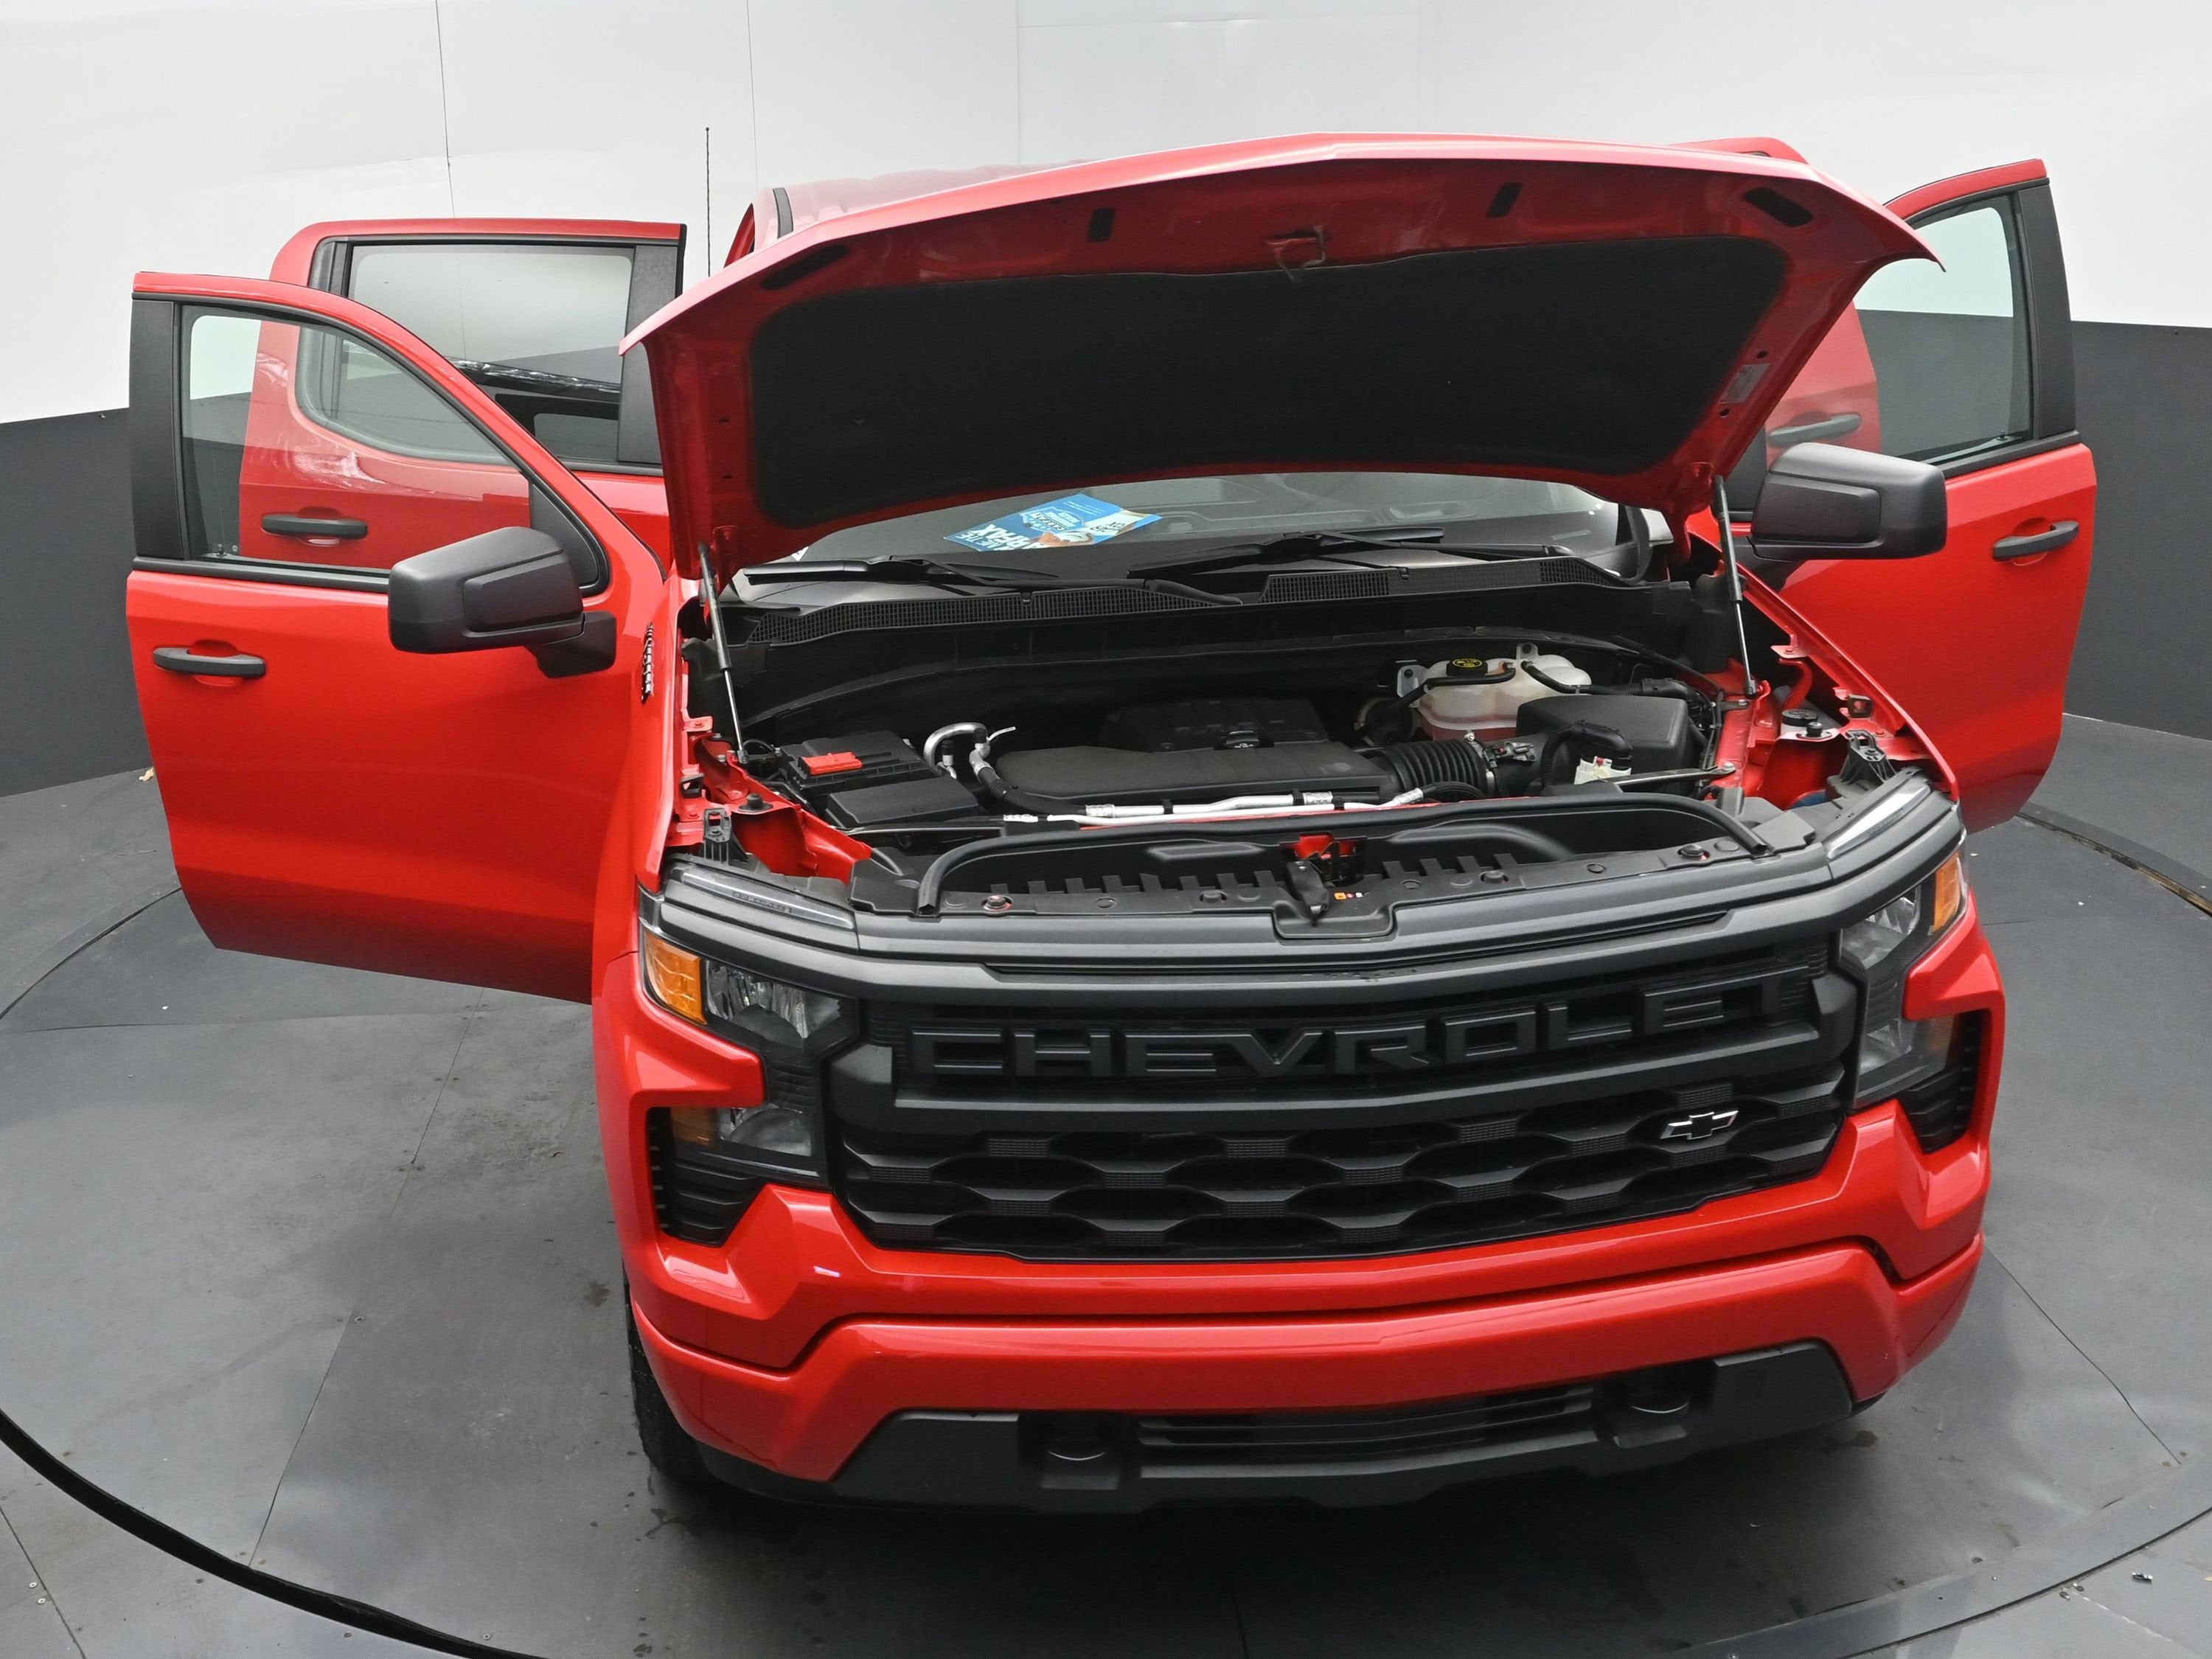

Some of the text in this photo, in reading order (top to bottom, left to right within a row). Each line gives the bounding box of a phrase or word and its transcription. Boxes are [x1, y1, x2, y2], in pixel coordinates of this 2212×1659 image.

[955, 530, 984, 543] THE
[967, 524, 1053, 550] ARFAX
[911, 964, 1814, 1077] CHEVROLET
